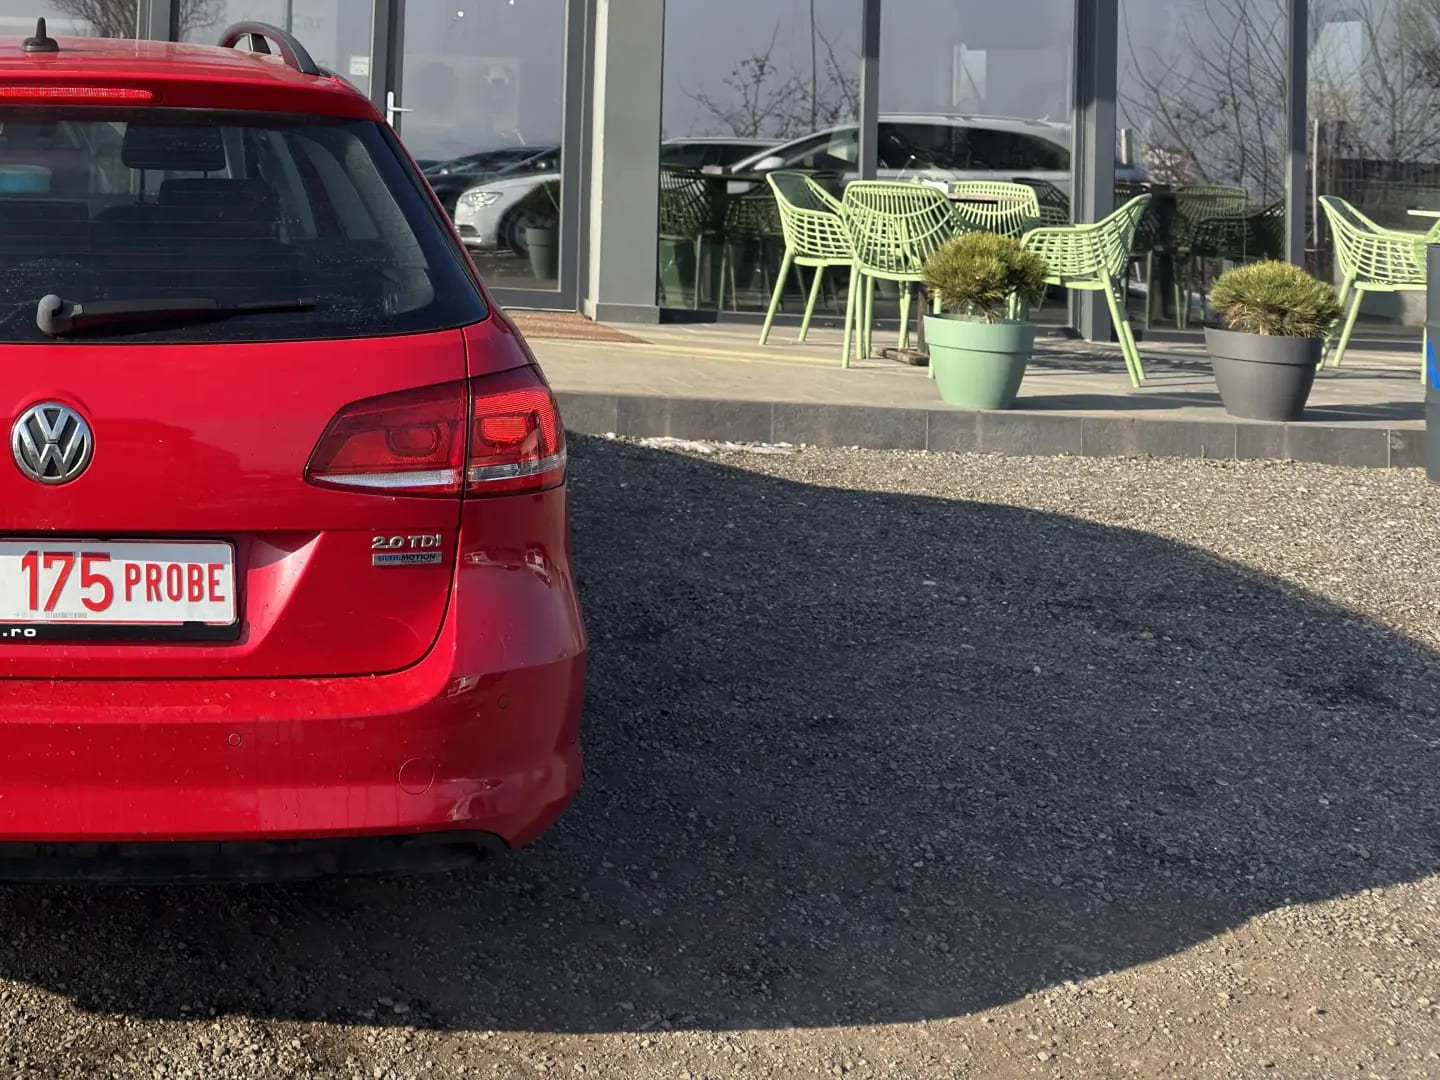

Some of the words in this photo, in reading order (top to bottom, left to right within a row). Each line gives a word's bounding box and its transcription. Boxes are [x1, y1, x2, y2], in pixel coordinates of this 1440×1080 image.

[371, 535, 405, 549] 2.0
[407, 533, 442, 549] TDI
[21, 550, 114, 612] 175
[124, 562, 226, 603] PROBE
